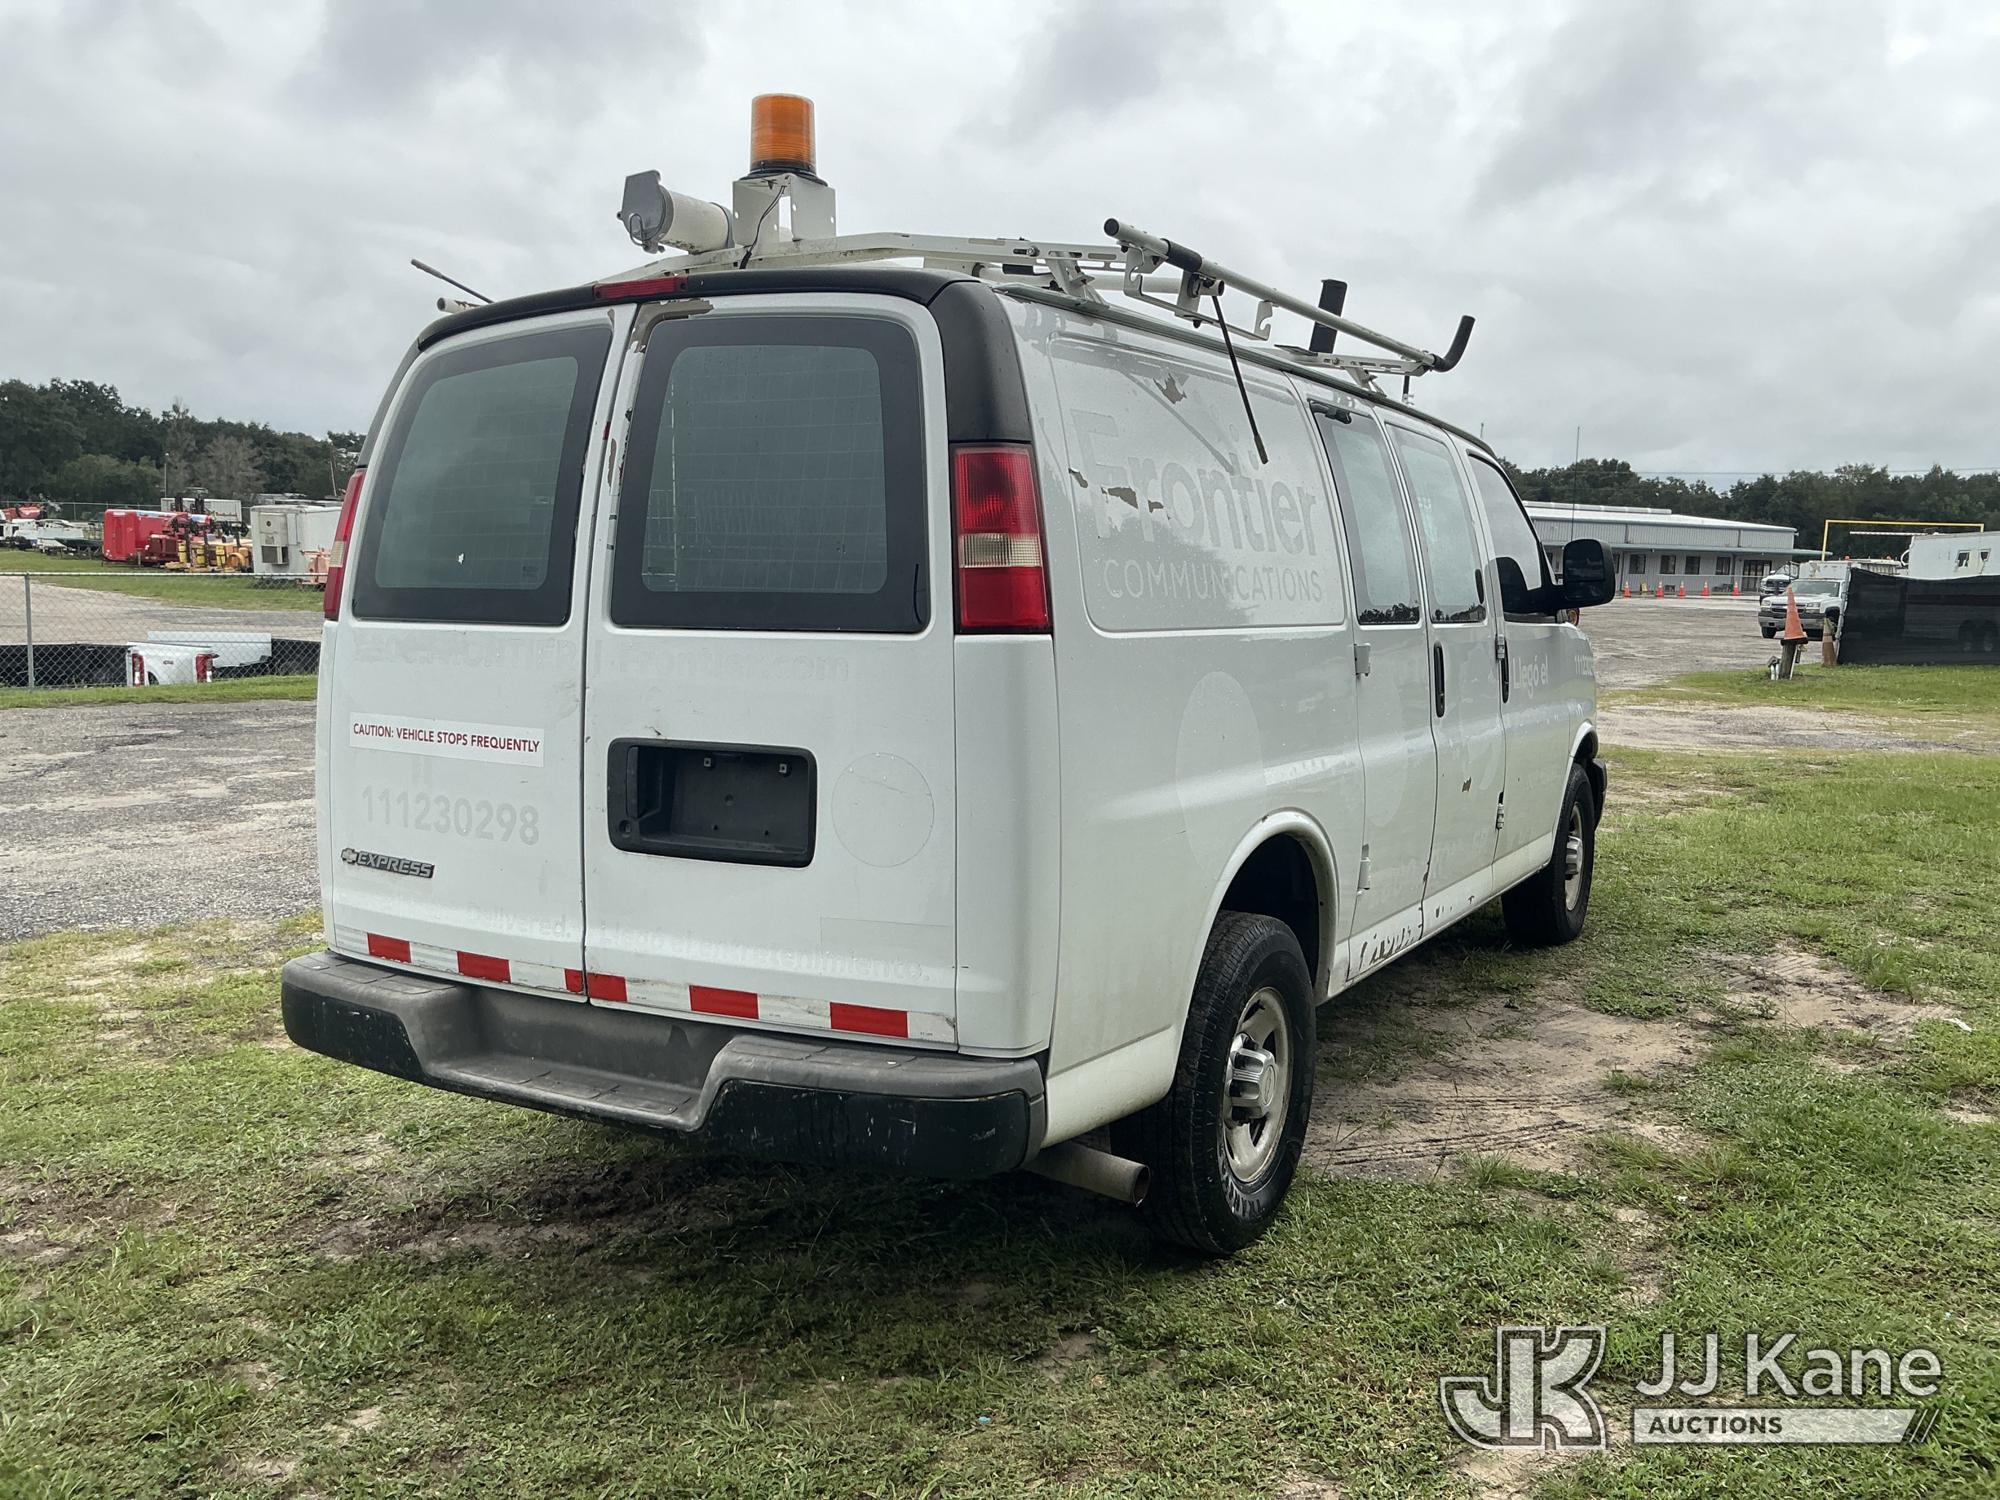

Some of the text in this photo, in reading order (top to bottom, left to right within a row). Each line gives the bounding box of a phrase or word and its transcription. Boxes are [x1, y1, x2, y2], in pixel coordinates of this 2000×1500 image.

[1070, 409, 1316, 556] Frontier
[1103, 558, 1323, 603] COMMUNICATIONS
[353, 722, 540, 753] CAUTION: VEHICLE STOPS FREQUENTLY
[361, 784, 540, 846] 111230298
[356, 850, 433, 878] EXPRESS
